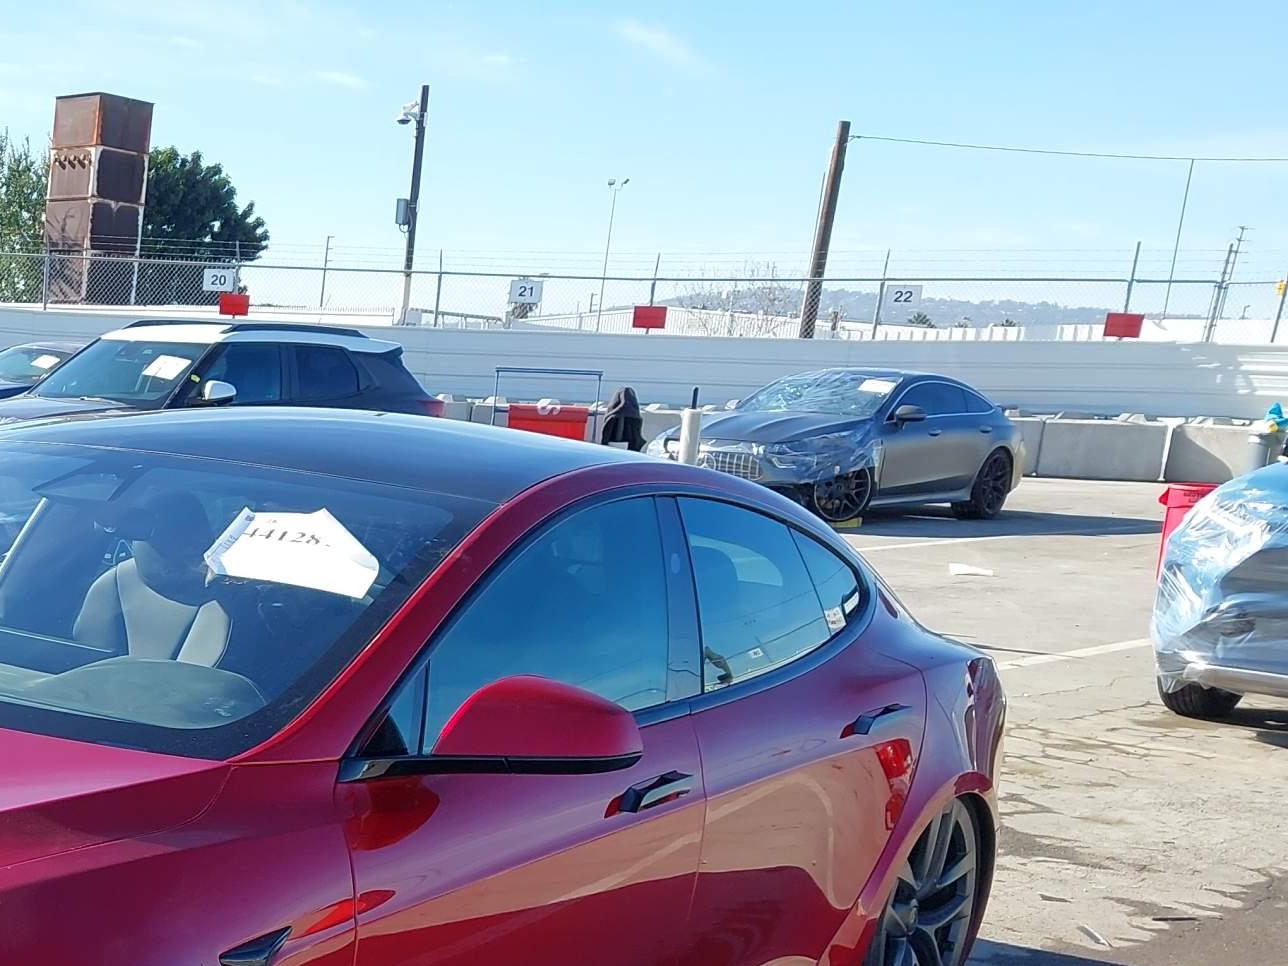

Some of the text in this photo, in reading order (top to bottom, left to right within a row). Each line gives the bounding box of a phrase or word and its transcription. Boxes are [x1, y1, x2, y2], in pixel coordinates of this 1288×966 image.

[211, 274, 227, 286] 20
[518, 285, 534, 297] 21
[893, 290, 913, 303] 22
